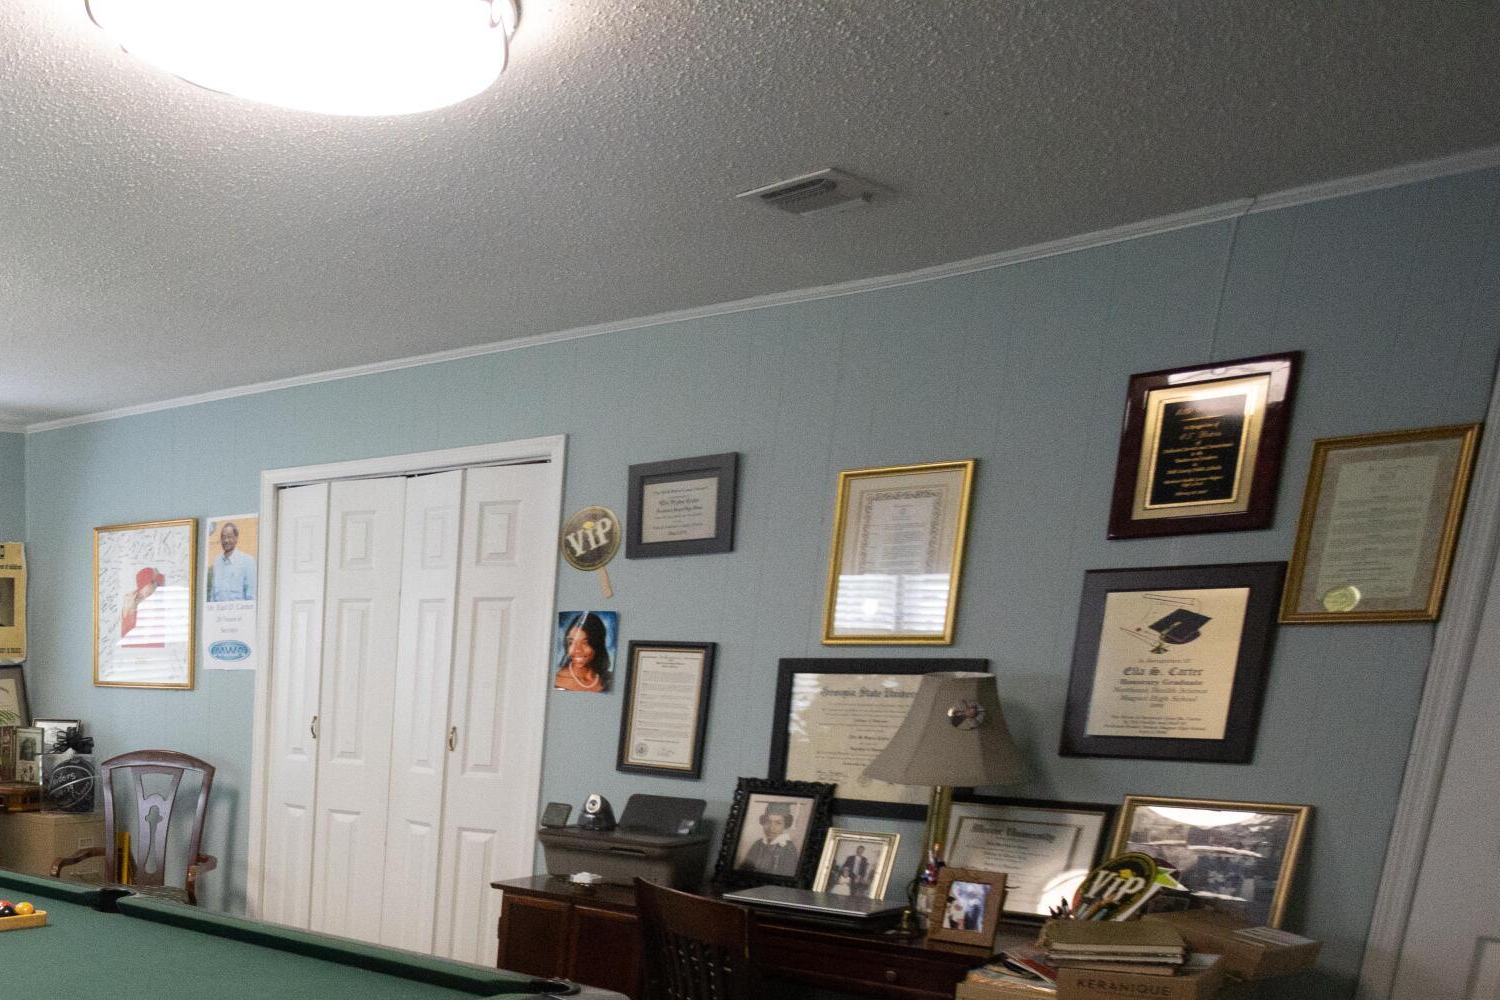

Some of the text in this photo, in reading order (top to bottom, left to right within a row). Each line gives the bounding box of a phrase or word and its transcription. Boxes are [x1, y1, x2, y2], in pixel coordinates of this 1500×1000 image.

[566, 518, 612, 557] VIP
[1123, 667, 1144, 676] Ella
[1169, 667, 1204, 676] Carter
[1084, 869, 1146, 905] VIP
[1077, 978, 1173, 997] KERANIQUE
